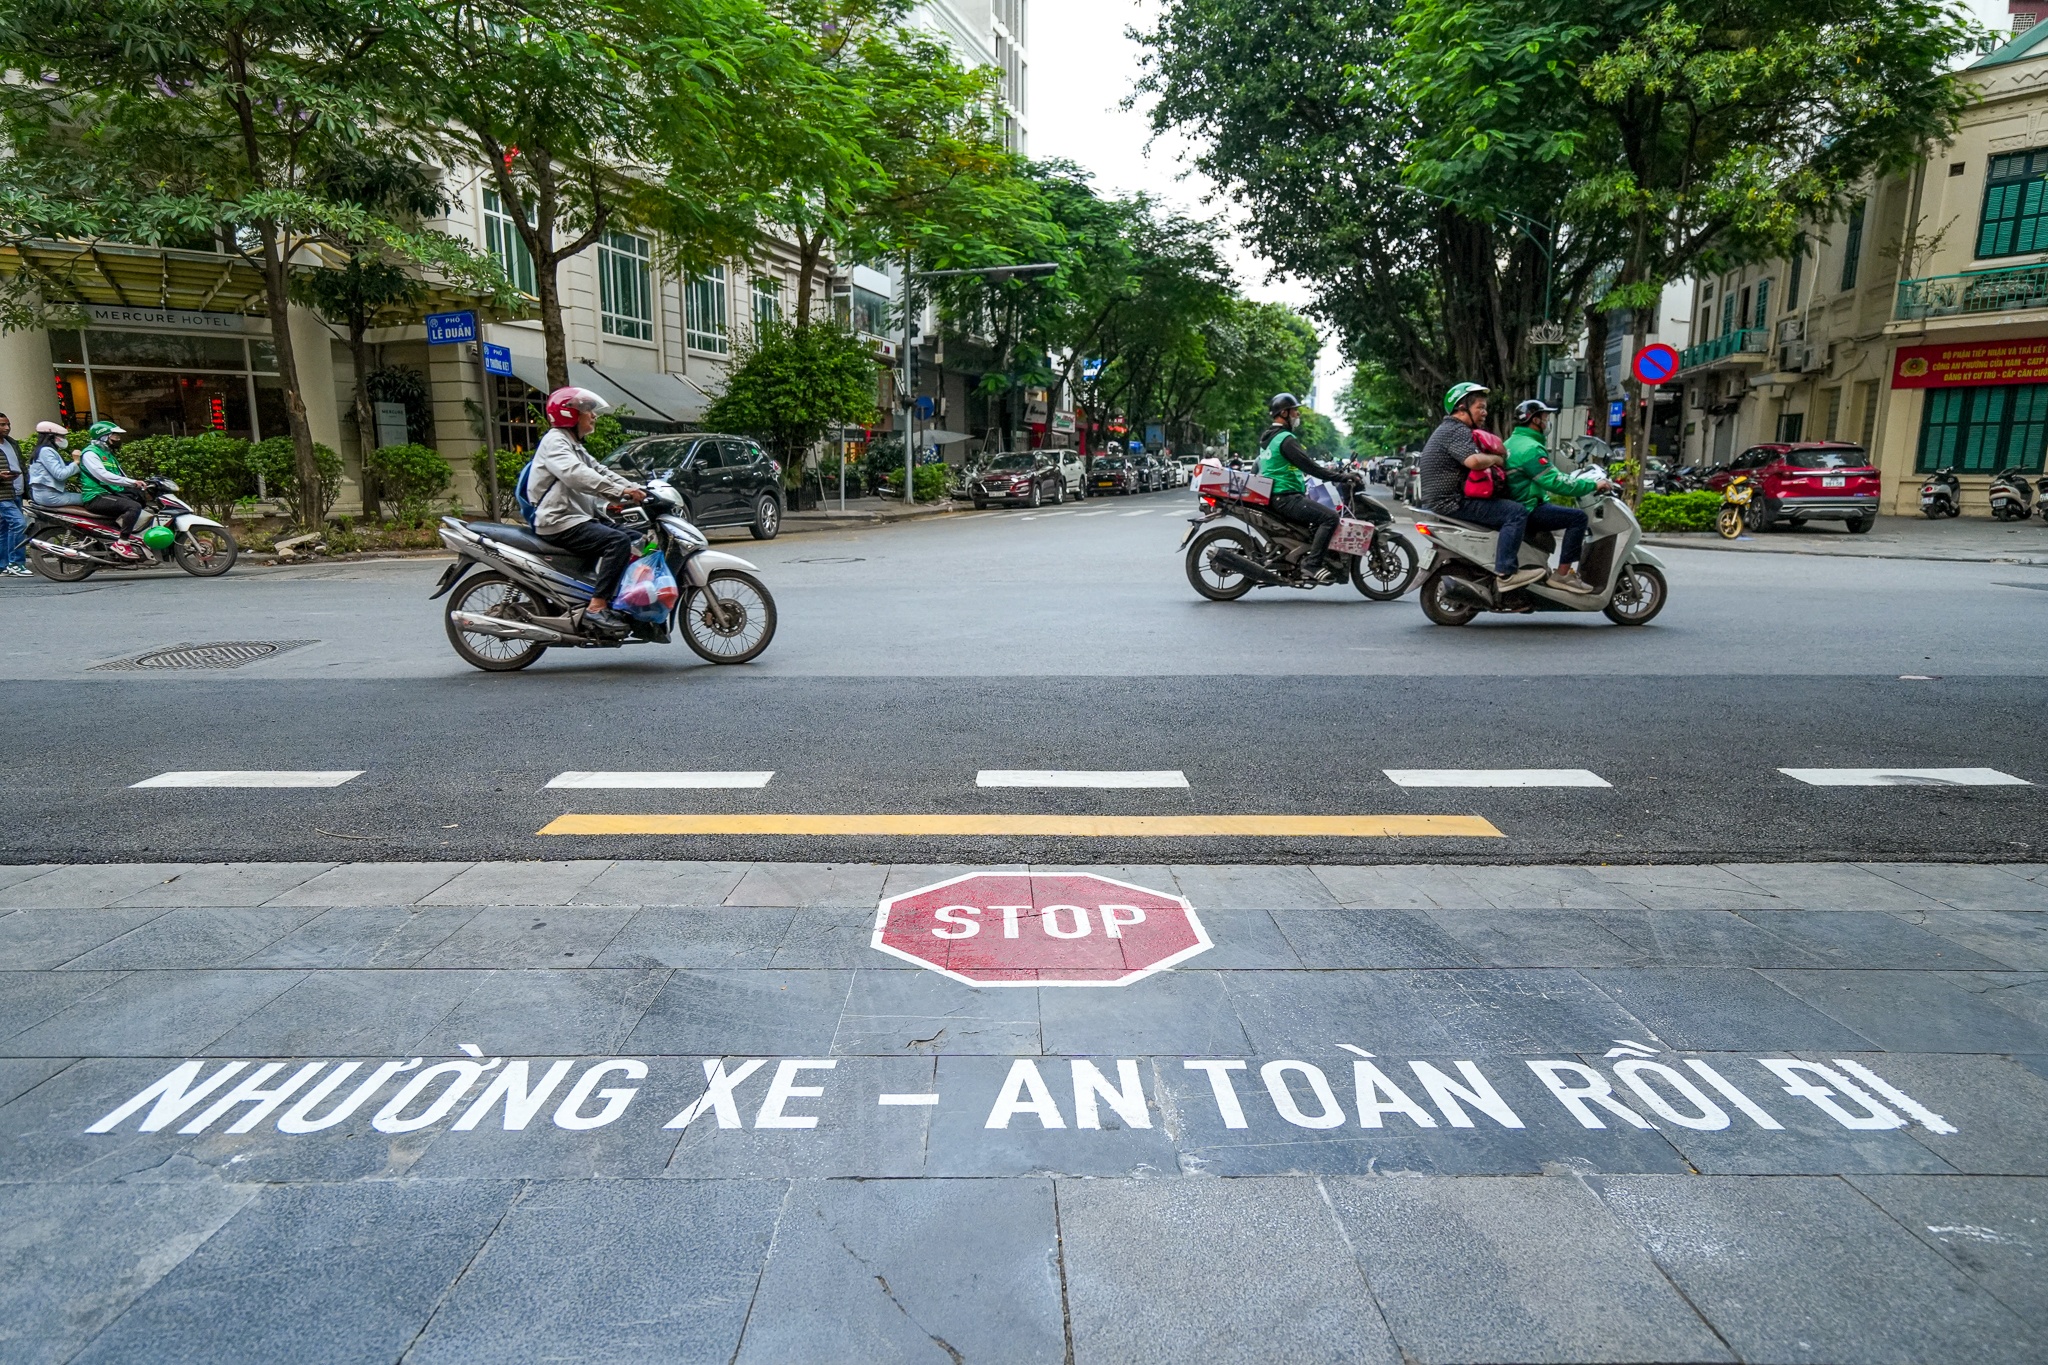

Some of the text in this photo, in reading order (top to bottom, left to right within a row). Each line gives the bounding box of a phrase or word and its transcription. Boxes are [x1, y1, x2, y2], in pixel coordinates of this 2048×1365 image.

[95, 310, 231, 327] MERCURE HOTEL
[445, 316, 461, 324] PHỐ
[432, 322, 472, 340] LÊ DUẨN
[1932, 361, 1950, 371] CÔNG
[1950, 362, 1961, 370] AN
[2001, 369, 2016, 379] CẤP
[2017, 369, 2032, 378] CĂN
[932, 905, 1146, 939] STOP
[85, 1044, 648, 1134] NHƯỜNG
[662, 1059, 838, 1130] XE
[984, 1059, 1153, 1130] AN
[1183, 1044, 1525, 1130] TOÀN
[1525, 1040, 1785, 1131] RỒI
[1756, 1059, 1958, 1135] ĐI
